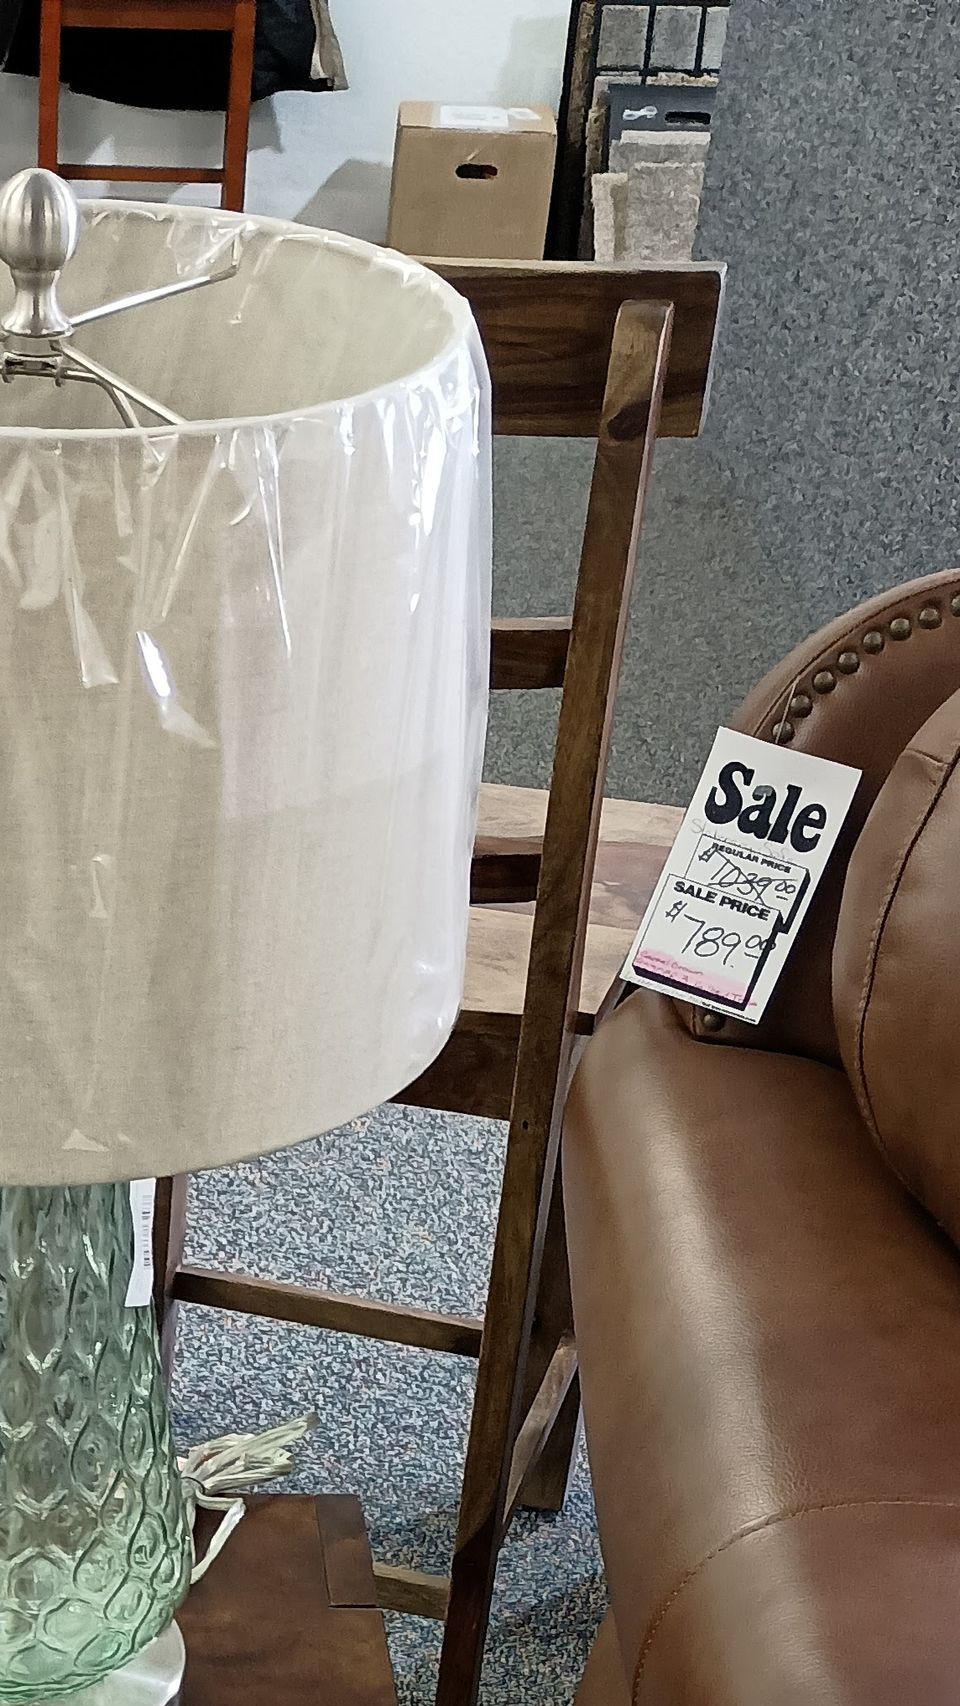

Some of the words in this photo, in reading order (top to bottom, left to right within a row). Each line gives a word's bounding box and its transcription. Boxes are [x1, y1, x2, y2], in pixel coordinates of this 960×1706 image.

[704, 761, 827, 853] Sale
[711, 842, 759, 863] REGULAR
[760, 857, 792, 874] PRICE
[673, 880, 717, 904] SALE
[718, 897, 771, 921] PRICE
